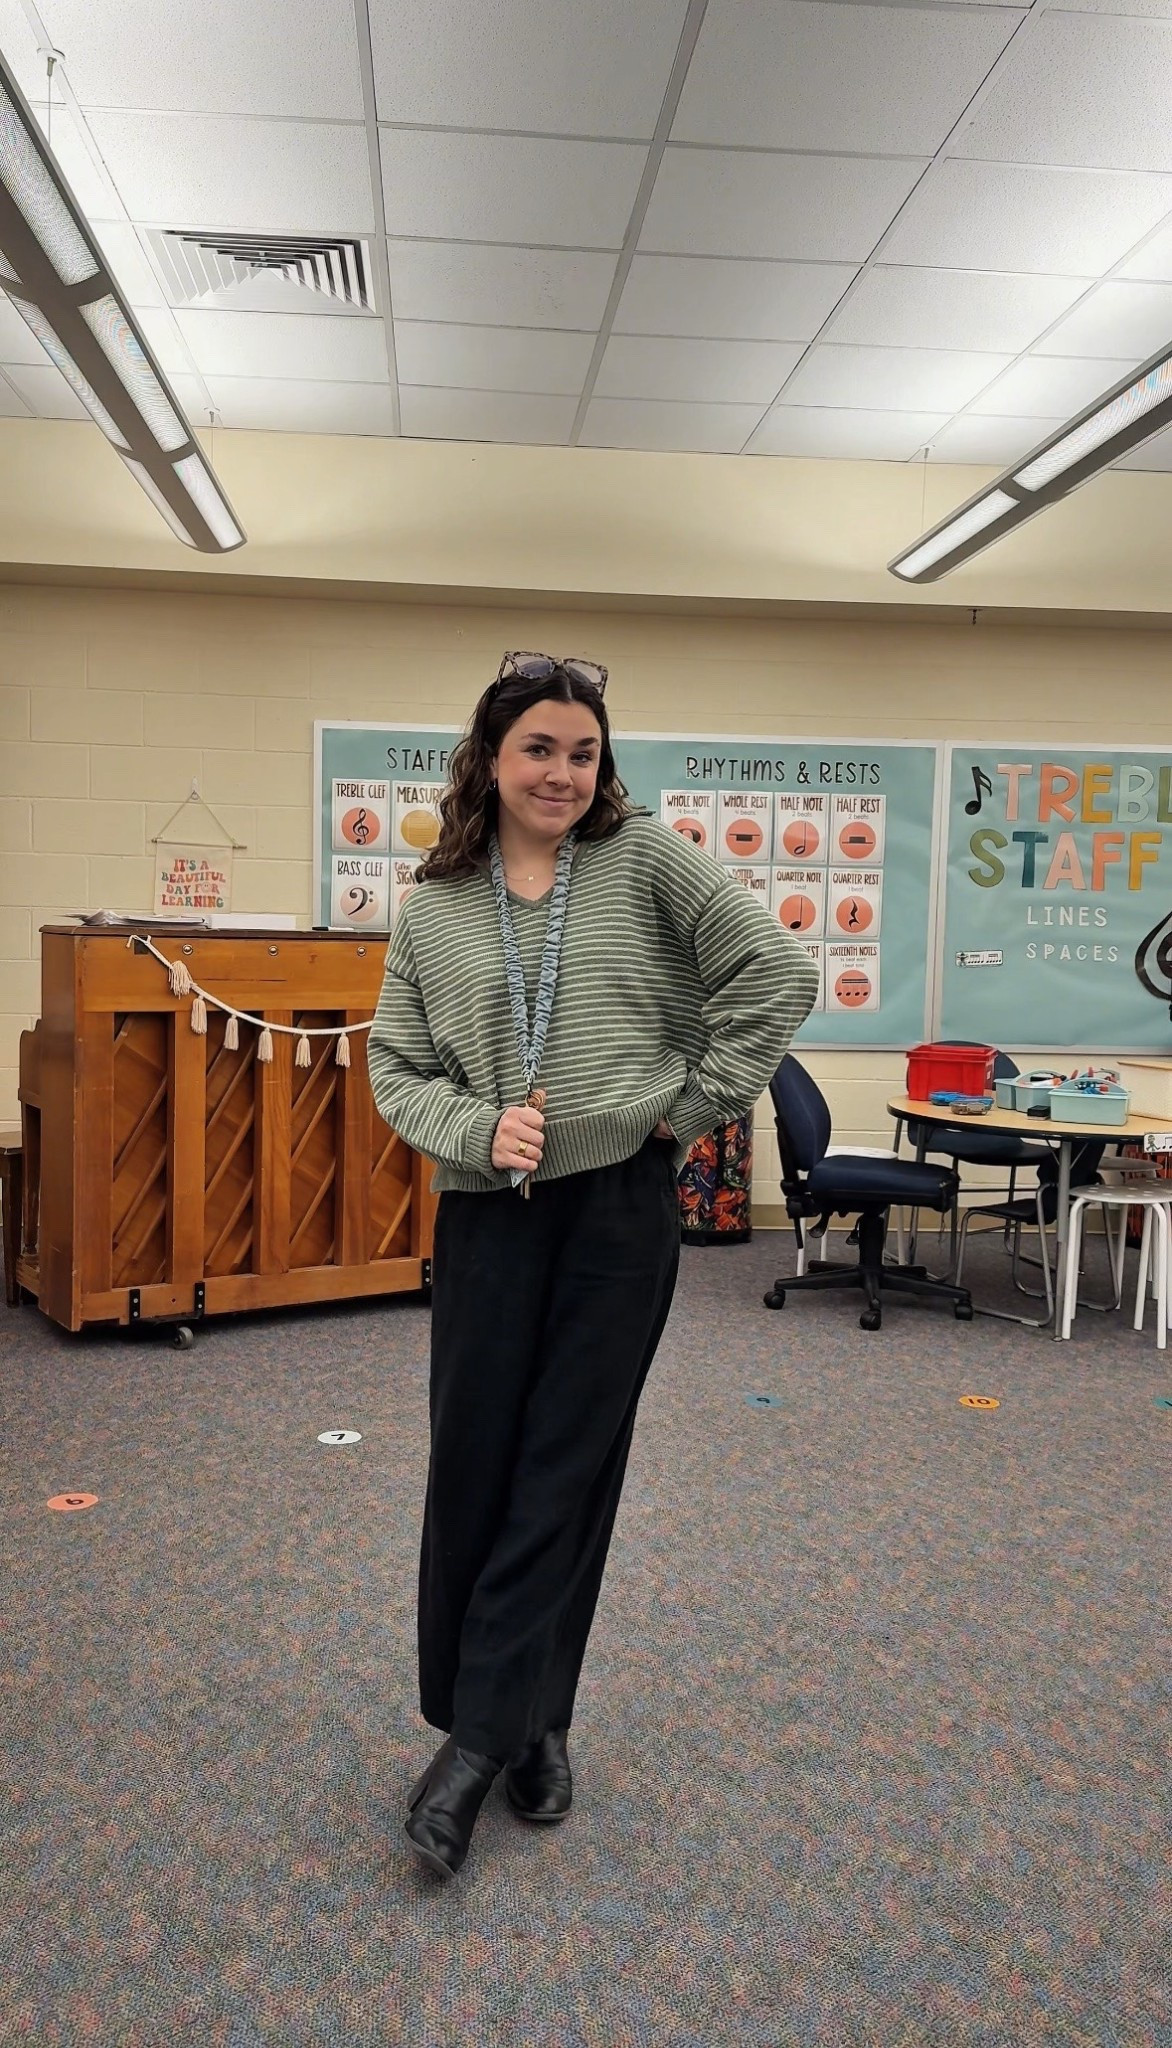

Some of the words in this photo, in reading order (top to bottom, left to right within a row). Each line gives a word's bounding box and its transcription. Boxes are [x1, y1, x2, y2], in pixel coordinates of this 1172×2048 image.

[386, 747, 448, 772] STAFF
[686, 756, 786, 783] RHYTHMS
[796, 760, 811, 784] &
[819, 761, 881, 784] RESTS
[336, 783, 365, 799] TREBLE
[368, 784, 386, 799] CLEF
[996, 762, 1172, 823] TREBL
[666, 794, 691, 808] WHOLE
[693, 795, 710, 808] NOTE
[723, 795, 749, 809] WHOLE
[751, 796, 768, 809] REST
[780, 796, 801, 811] HALF
[803, 797, 824, 812] NOTE
[836, 797, 857, 813] HALF
[860, 798, 881, 813] REST
[173, 859, 196, 872] IT'S
[200, 860, 209, 870] A
[968, 828, 1163, 891] STAFF
[337, 860, 361, 876] BASS
[364, 861, 384, 877] CLEF
[161, 871, 226, 883] BEAUTIFUL
[776, 871, 804, 883] QUARTER
[806, 871, 822, 884] NOTE
[832, 873, 862, 885] QUARTER
[864, 873, 879, 886] REST
[166, 883, 191, 895] DAY
[161, 894, 224, 908] LEARNING
[1027, 905, 1108, 927] LINES
[829, 946, 858, 957] SIXTEENTH
[859, 947, 877, 957] NOTES
[1026, 942, 1119, 962] SPACES
